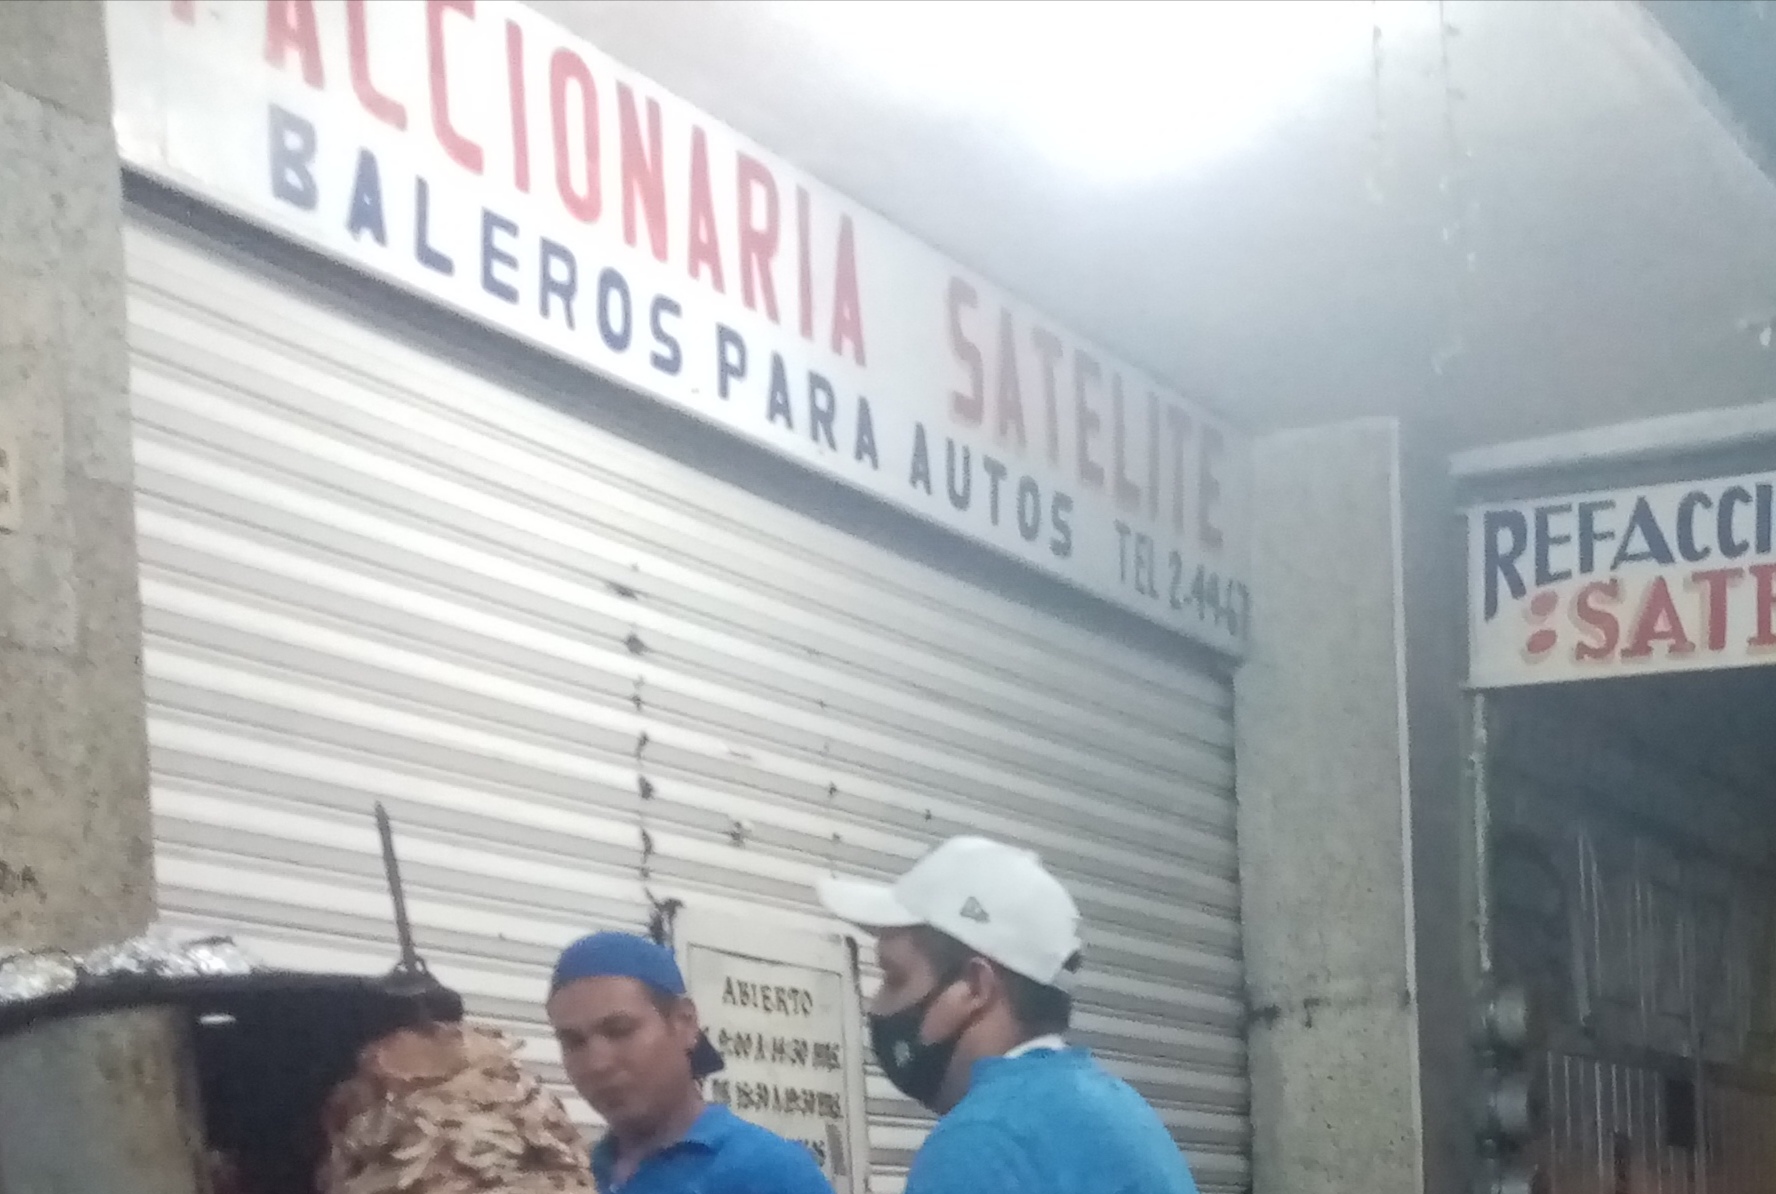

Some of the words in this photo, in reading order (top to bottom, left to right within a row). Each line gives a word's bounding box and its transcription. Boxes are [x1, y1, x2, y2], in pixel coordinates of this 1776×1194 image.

[170, 0, 867, 368] ACCIONARIA
[946, 275, 1224, 552] SATELITE
[266, 102, 683, 377] BALEROS
[716, 322, 879, 470] PARA
[909, 422, 1073, 558] AUTOS
[722, 976, 813, 1017] ABIERTO
